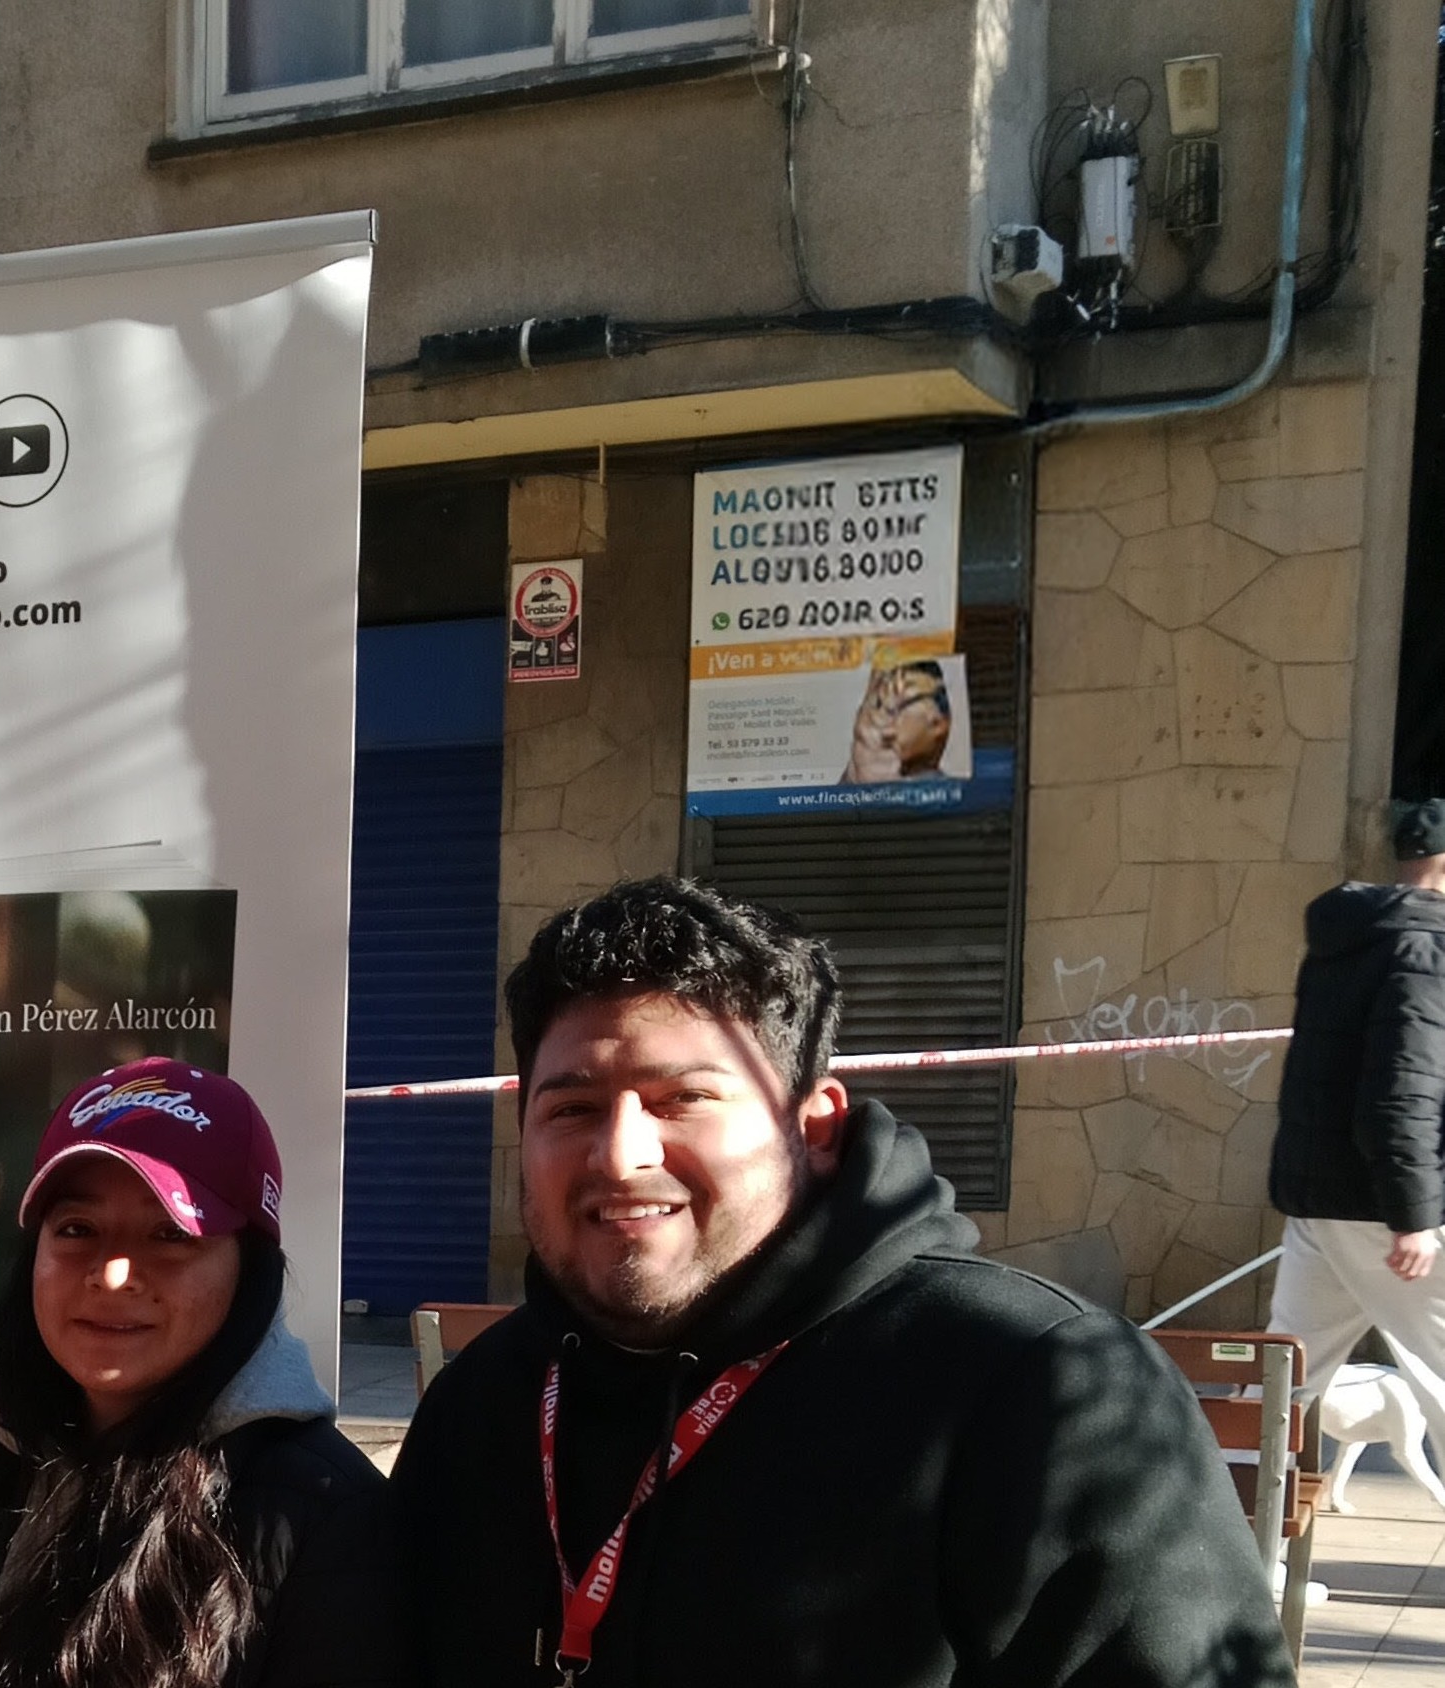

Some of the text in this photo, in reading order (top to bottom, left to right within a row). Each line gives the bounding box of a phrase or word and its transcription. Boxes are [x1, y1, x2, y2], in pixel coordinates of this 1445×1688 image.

[21, 999, 99, 1032] Pérez
[104, 997, 217, 1030] Alarcón
[68, 1084, 211, 1132] Ecuador
